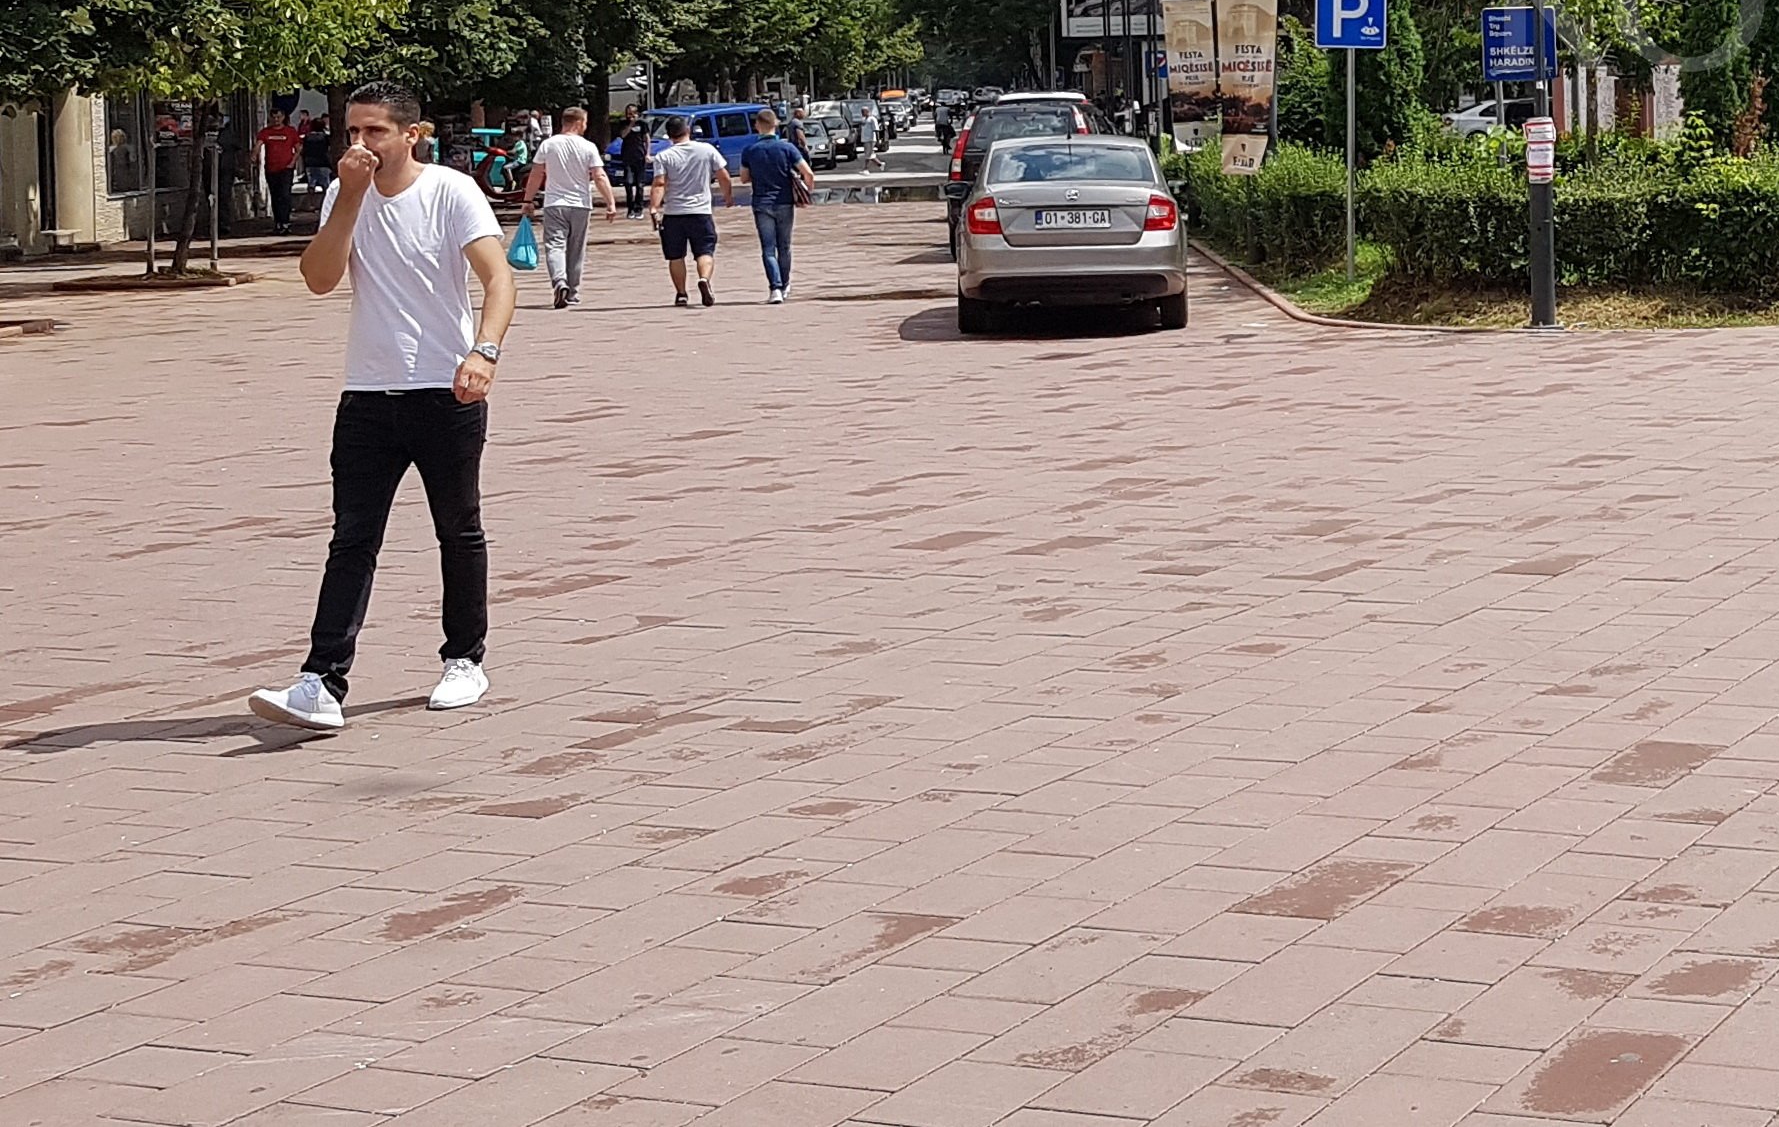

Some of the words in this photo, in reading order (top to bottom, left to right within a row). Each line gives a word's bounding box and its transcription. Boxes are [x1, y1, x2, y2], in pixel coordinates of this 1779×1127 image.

[1235, 44, 1262, 54] FESTA
[1489, 45, 1534, 56] SHKËLZE
[1180, 51, 1204, 59] FESTA
[1169, 61, 1214, 74] MIQËSISË
[1222, 59, 1272, 73] MIQËSISË
